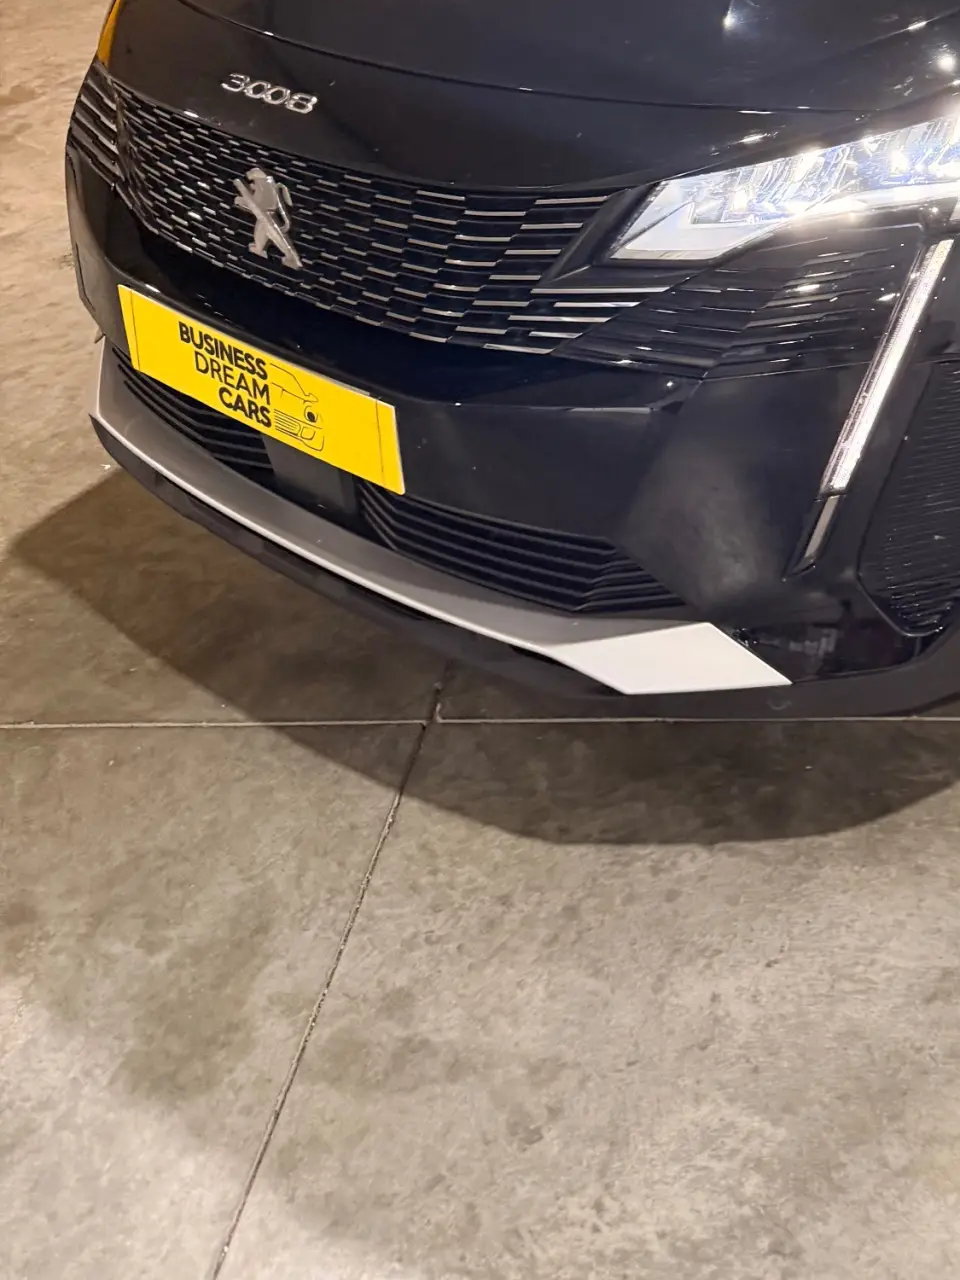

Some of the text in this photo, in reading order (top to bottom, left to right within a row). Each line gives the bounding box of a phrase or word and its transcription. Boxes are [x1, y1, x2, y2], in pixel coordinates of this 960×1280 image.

[221, 73, 318, 114] 3008
[178, 320, 268, 380] BUSINESS
[194, 349, 271, 406] DREAM
[218, 386, 272, 428] CARS
